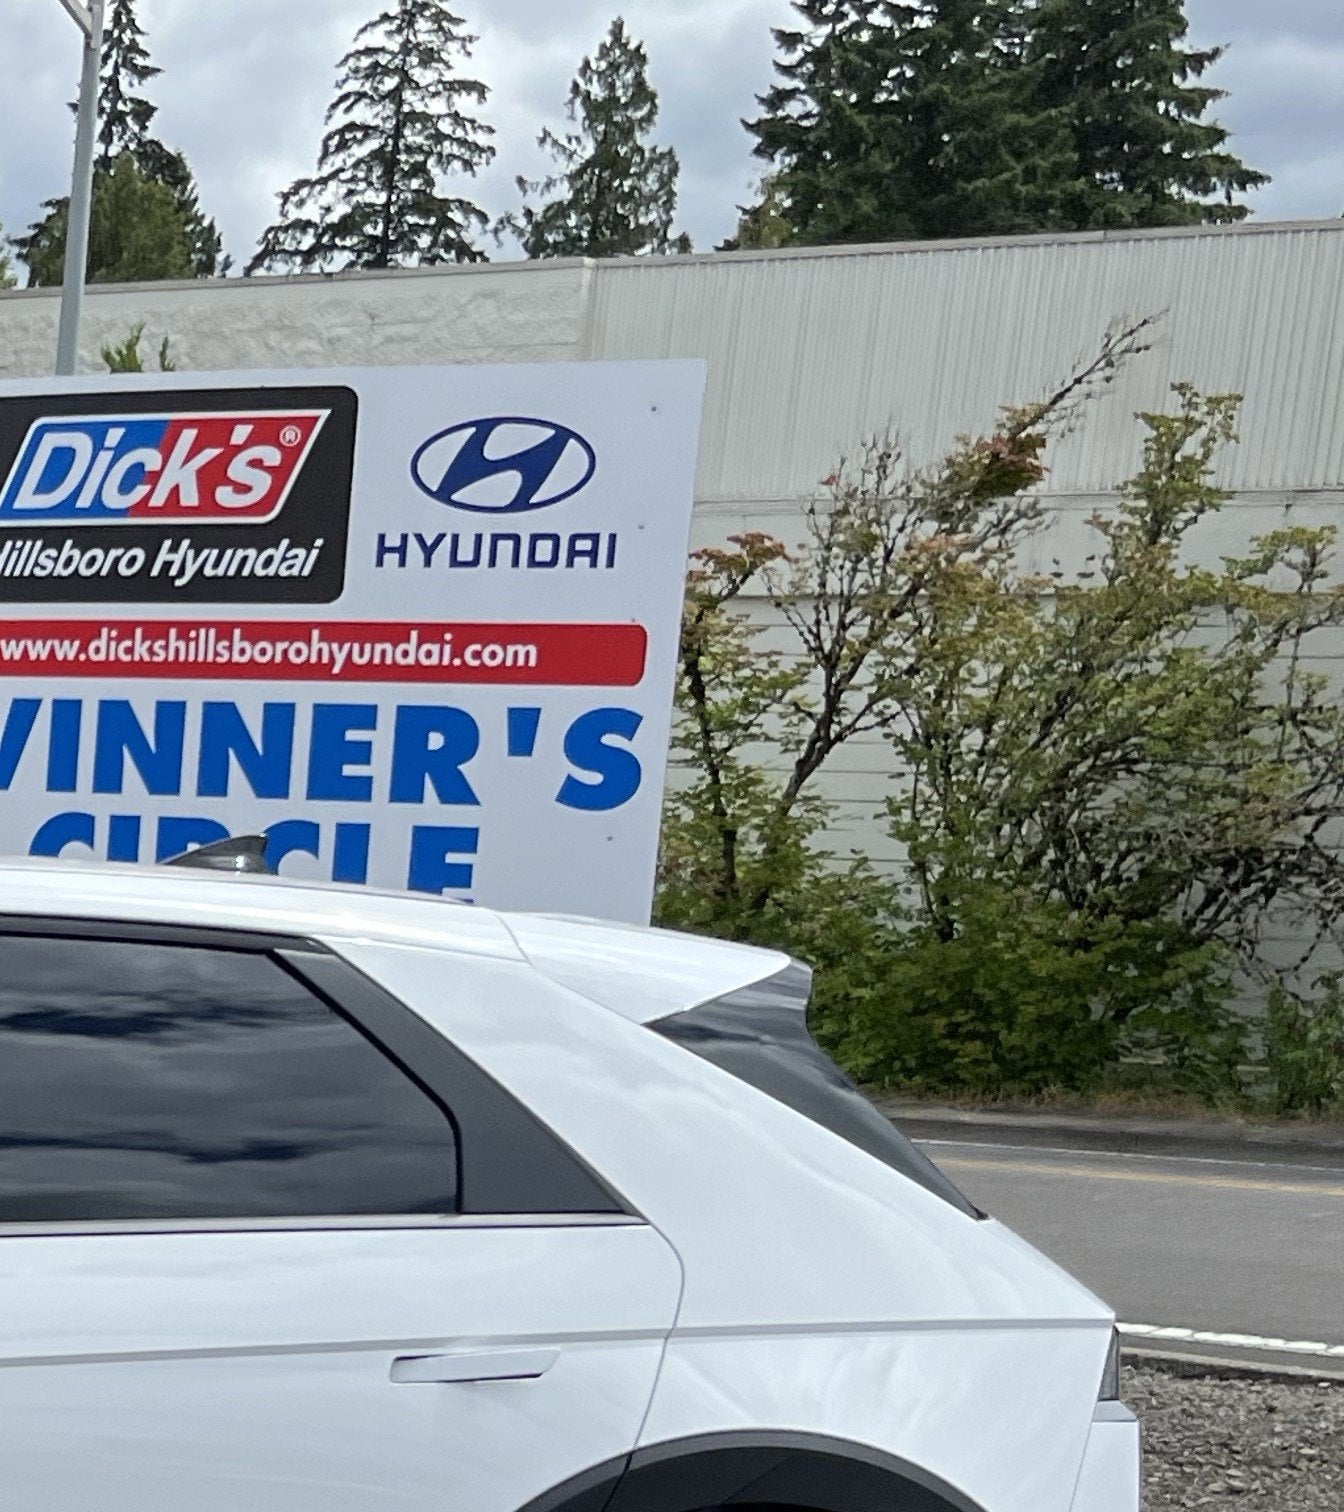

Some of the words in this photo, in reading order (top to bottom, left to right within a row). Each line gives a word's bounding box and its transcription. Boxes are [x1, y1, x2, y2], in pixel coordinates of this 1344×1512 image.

[150, 538, 324, 587] Hyundai
[376, 533, 617, 570] HYUNDAI
[0, 627, 538, 674] www.dickshillsborohyundai.com
